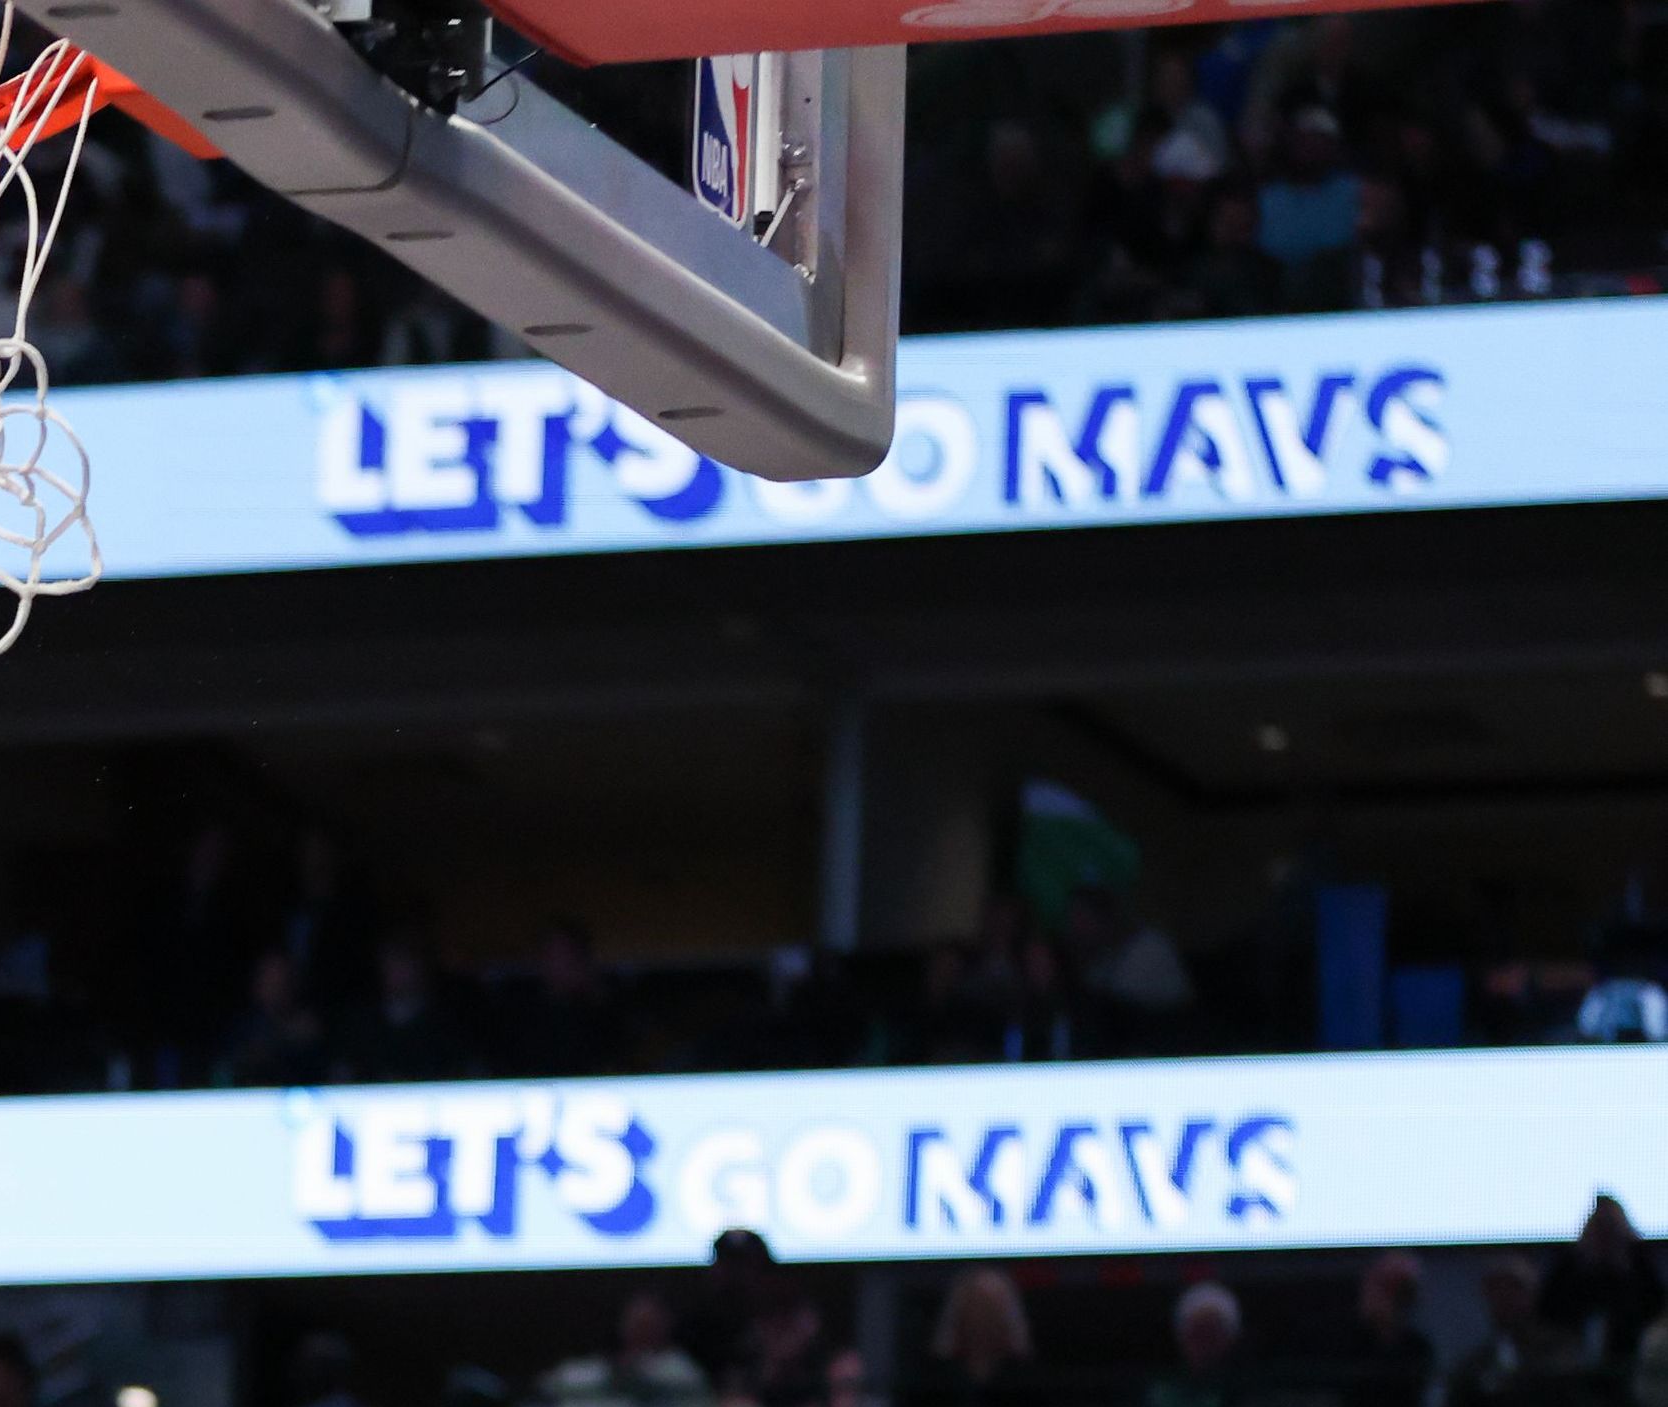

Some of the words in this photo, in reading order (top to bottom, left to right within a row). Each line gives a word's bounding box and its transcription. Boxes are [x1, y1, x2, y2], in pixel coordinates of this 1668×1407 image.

[1005, 366, 1451, 505] MAVS
[295, 1088, 657, 1237] LET'S
[679, 1127, 881, 1236] GO
[905, 1114, 1297, 1232] MAVS
